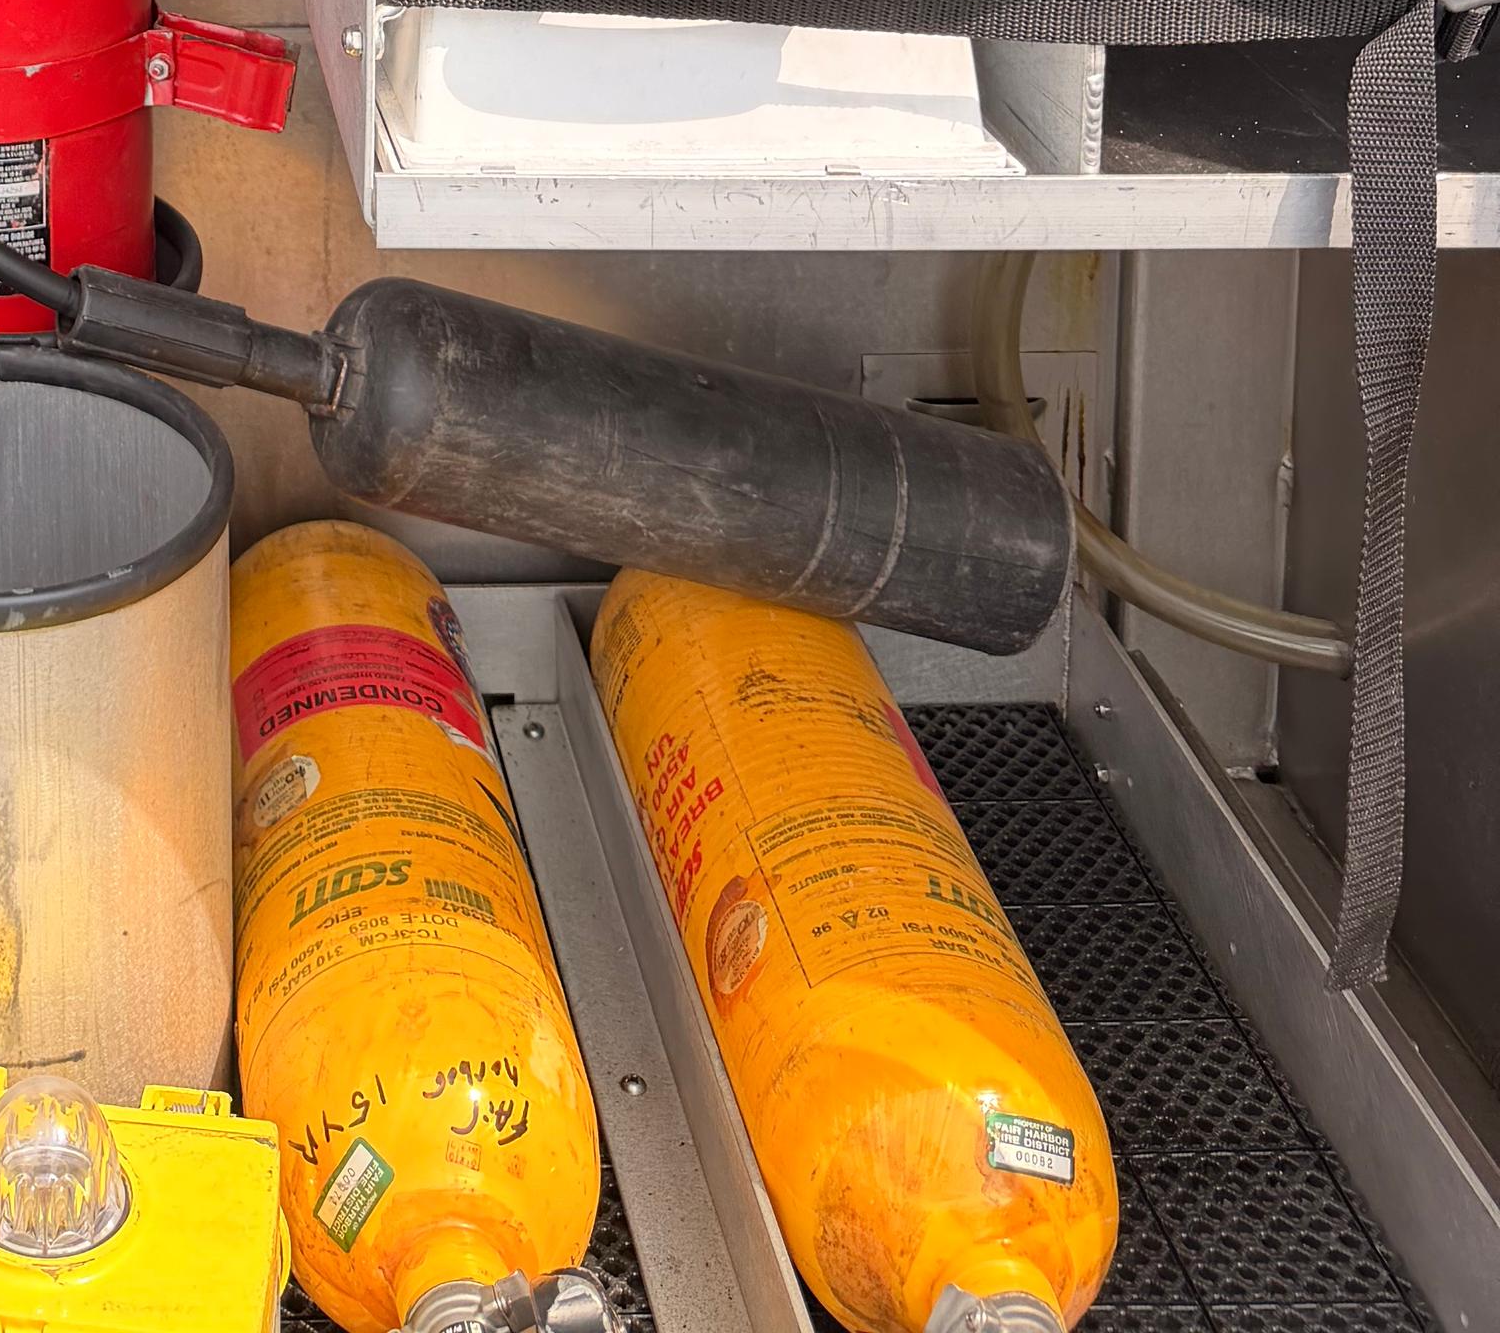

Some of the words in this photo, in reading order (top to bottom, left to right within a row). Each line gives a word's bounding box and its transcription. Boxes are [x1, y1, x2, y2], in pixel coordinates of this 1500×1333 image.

[259, 683, 445, 738] CONDEMNED
[652, 744, 690, 812] 4500
[666, 765, 696, 823] AIR
[288, 860, 412, 930] SCOTT
[787, 867, 839, 895] MINUTE
[348, 915, 389, 934] 8059
[400, 913, 458, 928] DOT-E
[901, 921, 933, 933] PSI
[358, 929, 441, 947] TC-3FCM
[928, 938, 970, 955] BAR
[290, 939, 324, 969] 4500
[315, 945, 344, 968] 310
[267, 967, 288, 997] PSI
[281, 965, 312, 997] BAR
[348, 1074, 387, 1129] 15
[1000, 1132, 1021, 1145] IRE
[1023, 1138, 1070, 1157] DISTRICT
[1024, 1128, 1069, 1147] HARBOR
[359, 1159, 380, 1188] FIRE
[364, 1167, 384, 1196] FAIR
[332, 1187, 361, 1235] DISTRICT
[337, 1195, 367, 1240] HARBOR
